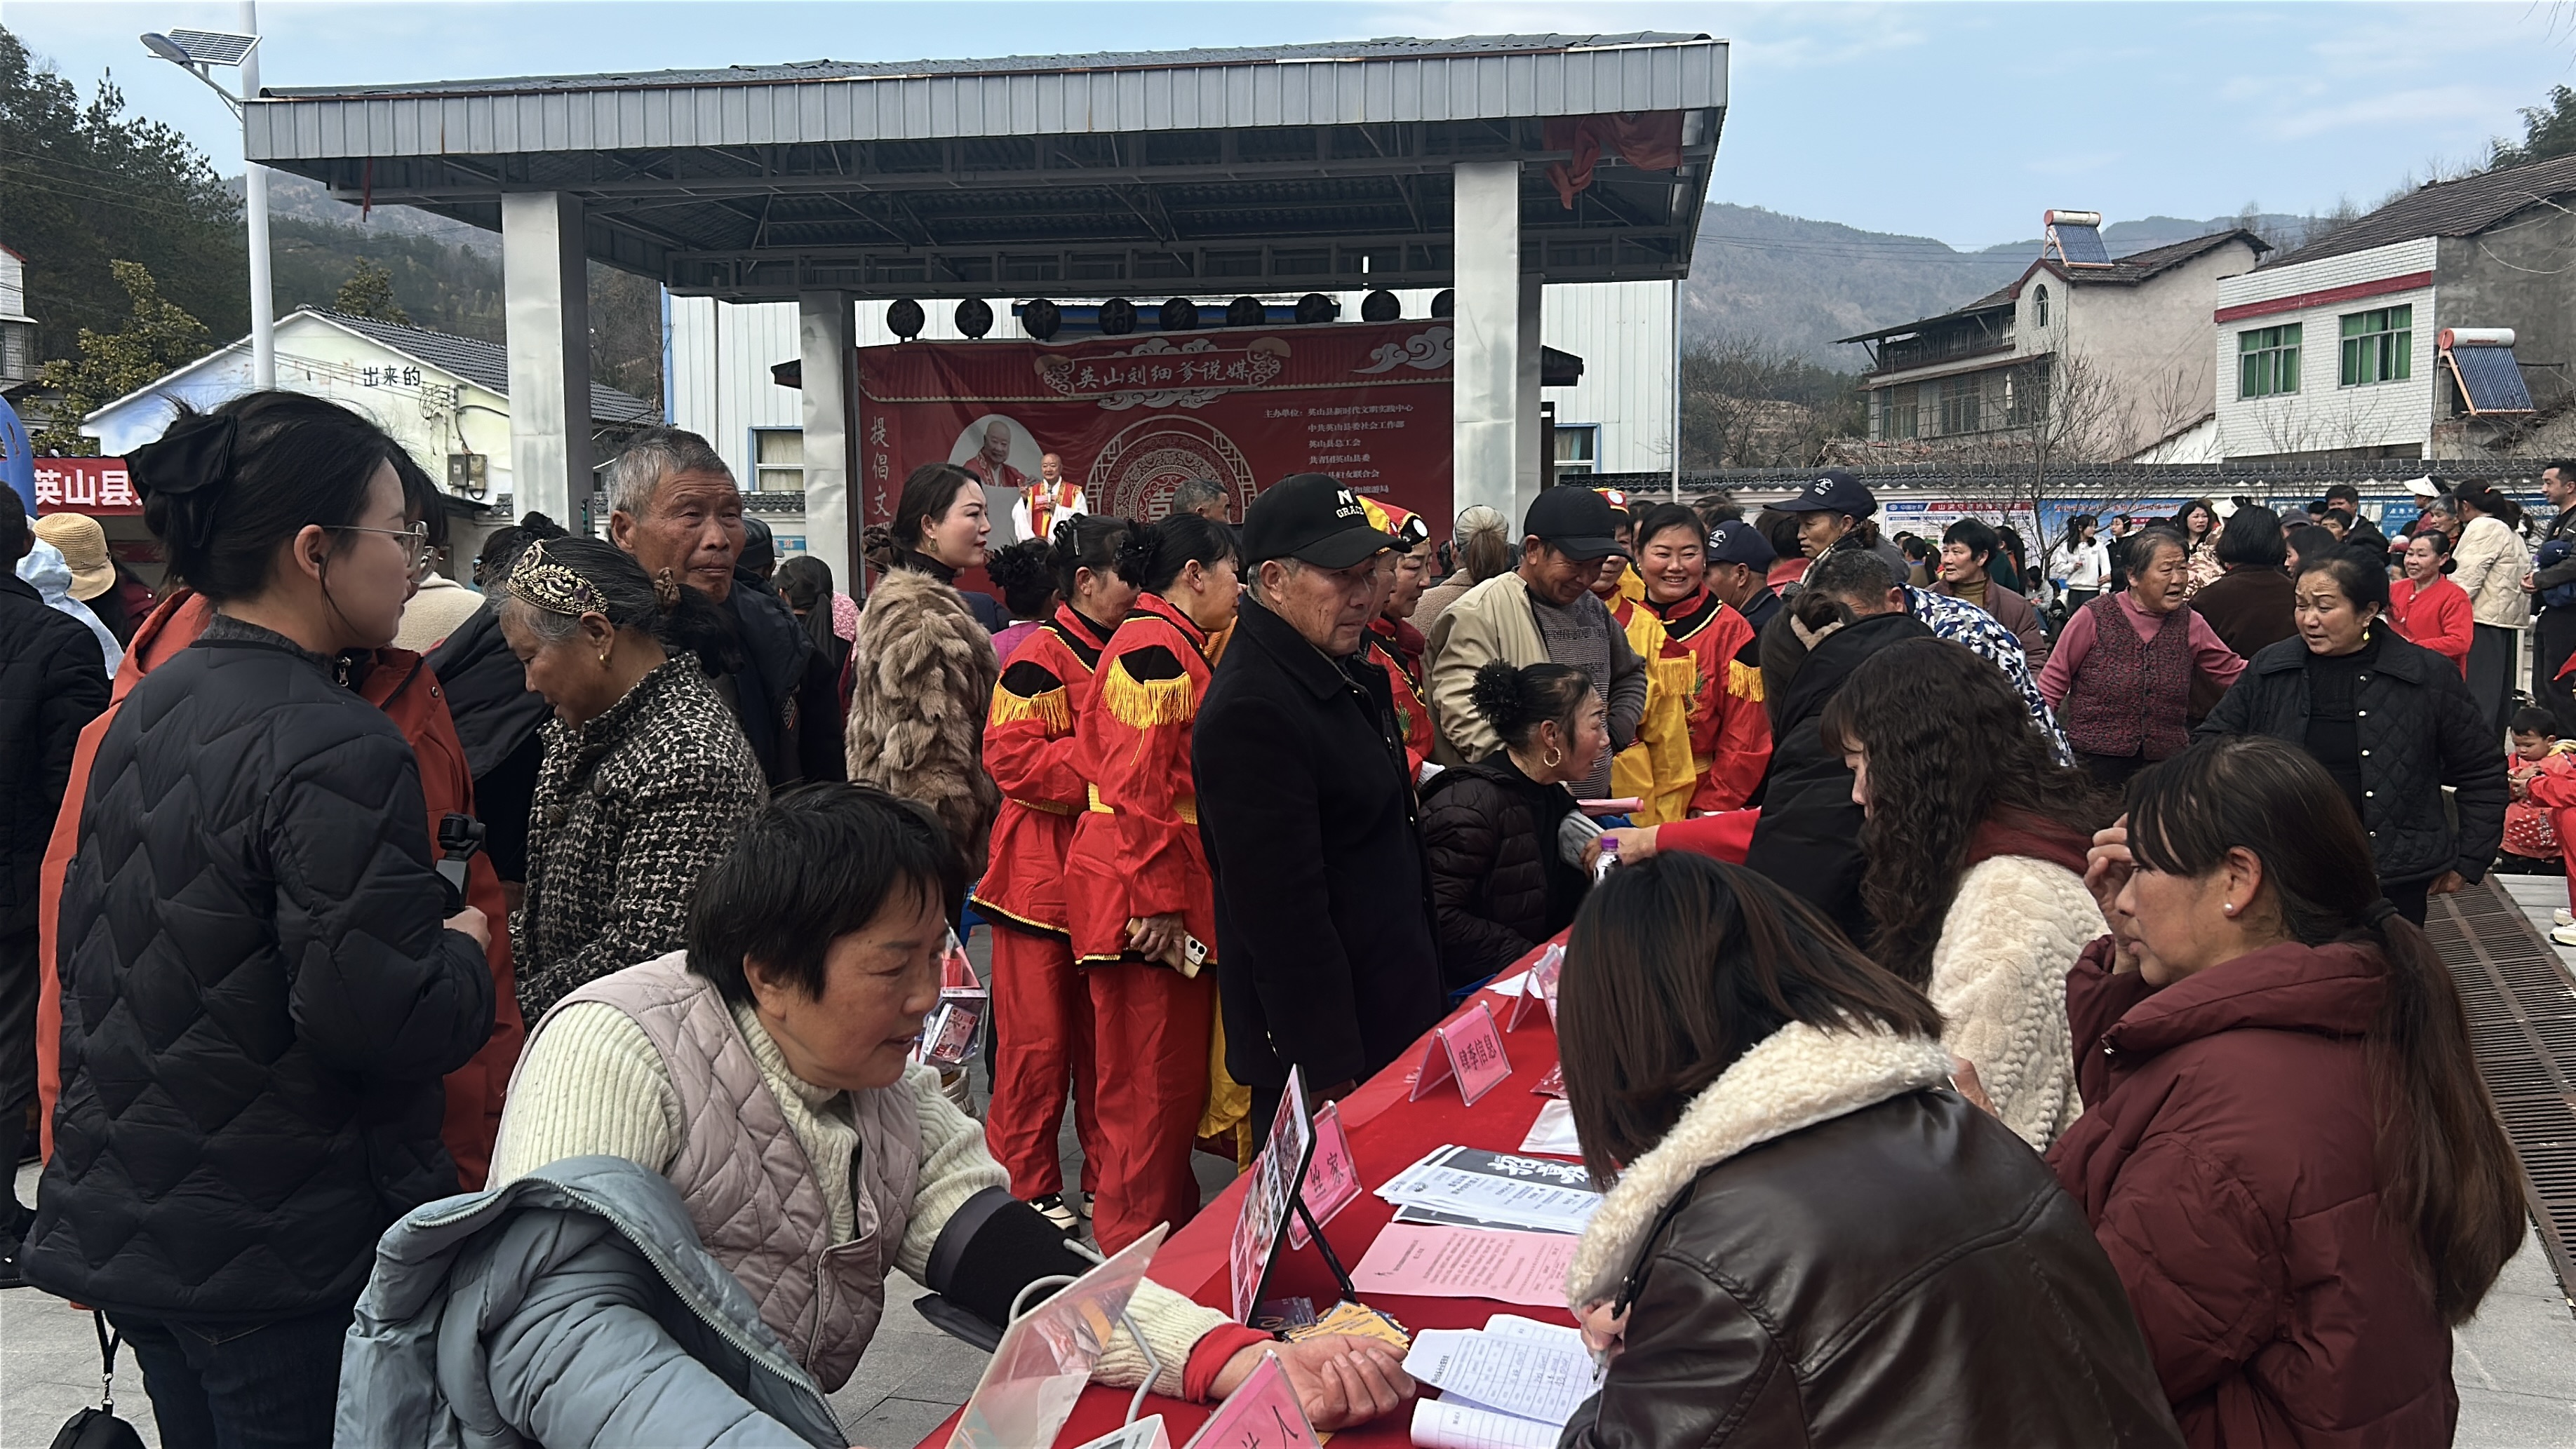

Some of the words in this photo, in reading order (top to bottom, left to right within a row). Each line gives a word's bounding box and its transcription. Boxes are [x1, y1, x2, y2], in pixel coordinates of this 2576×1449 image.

[363, 365, 421, 386] 出来的
[1076, 358, 1250, 389] 英山刘细爹说媒
[1308, 438, 1361, 449] 英山县总工会
[34, 469, 144, 507] 英山县
